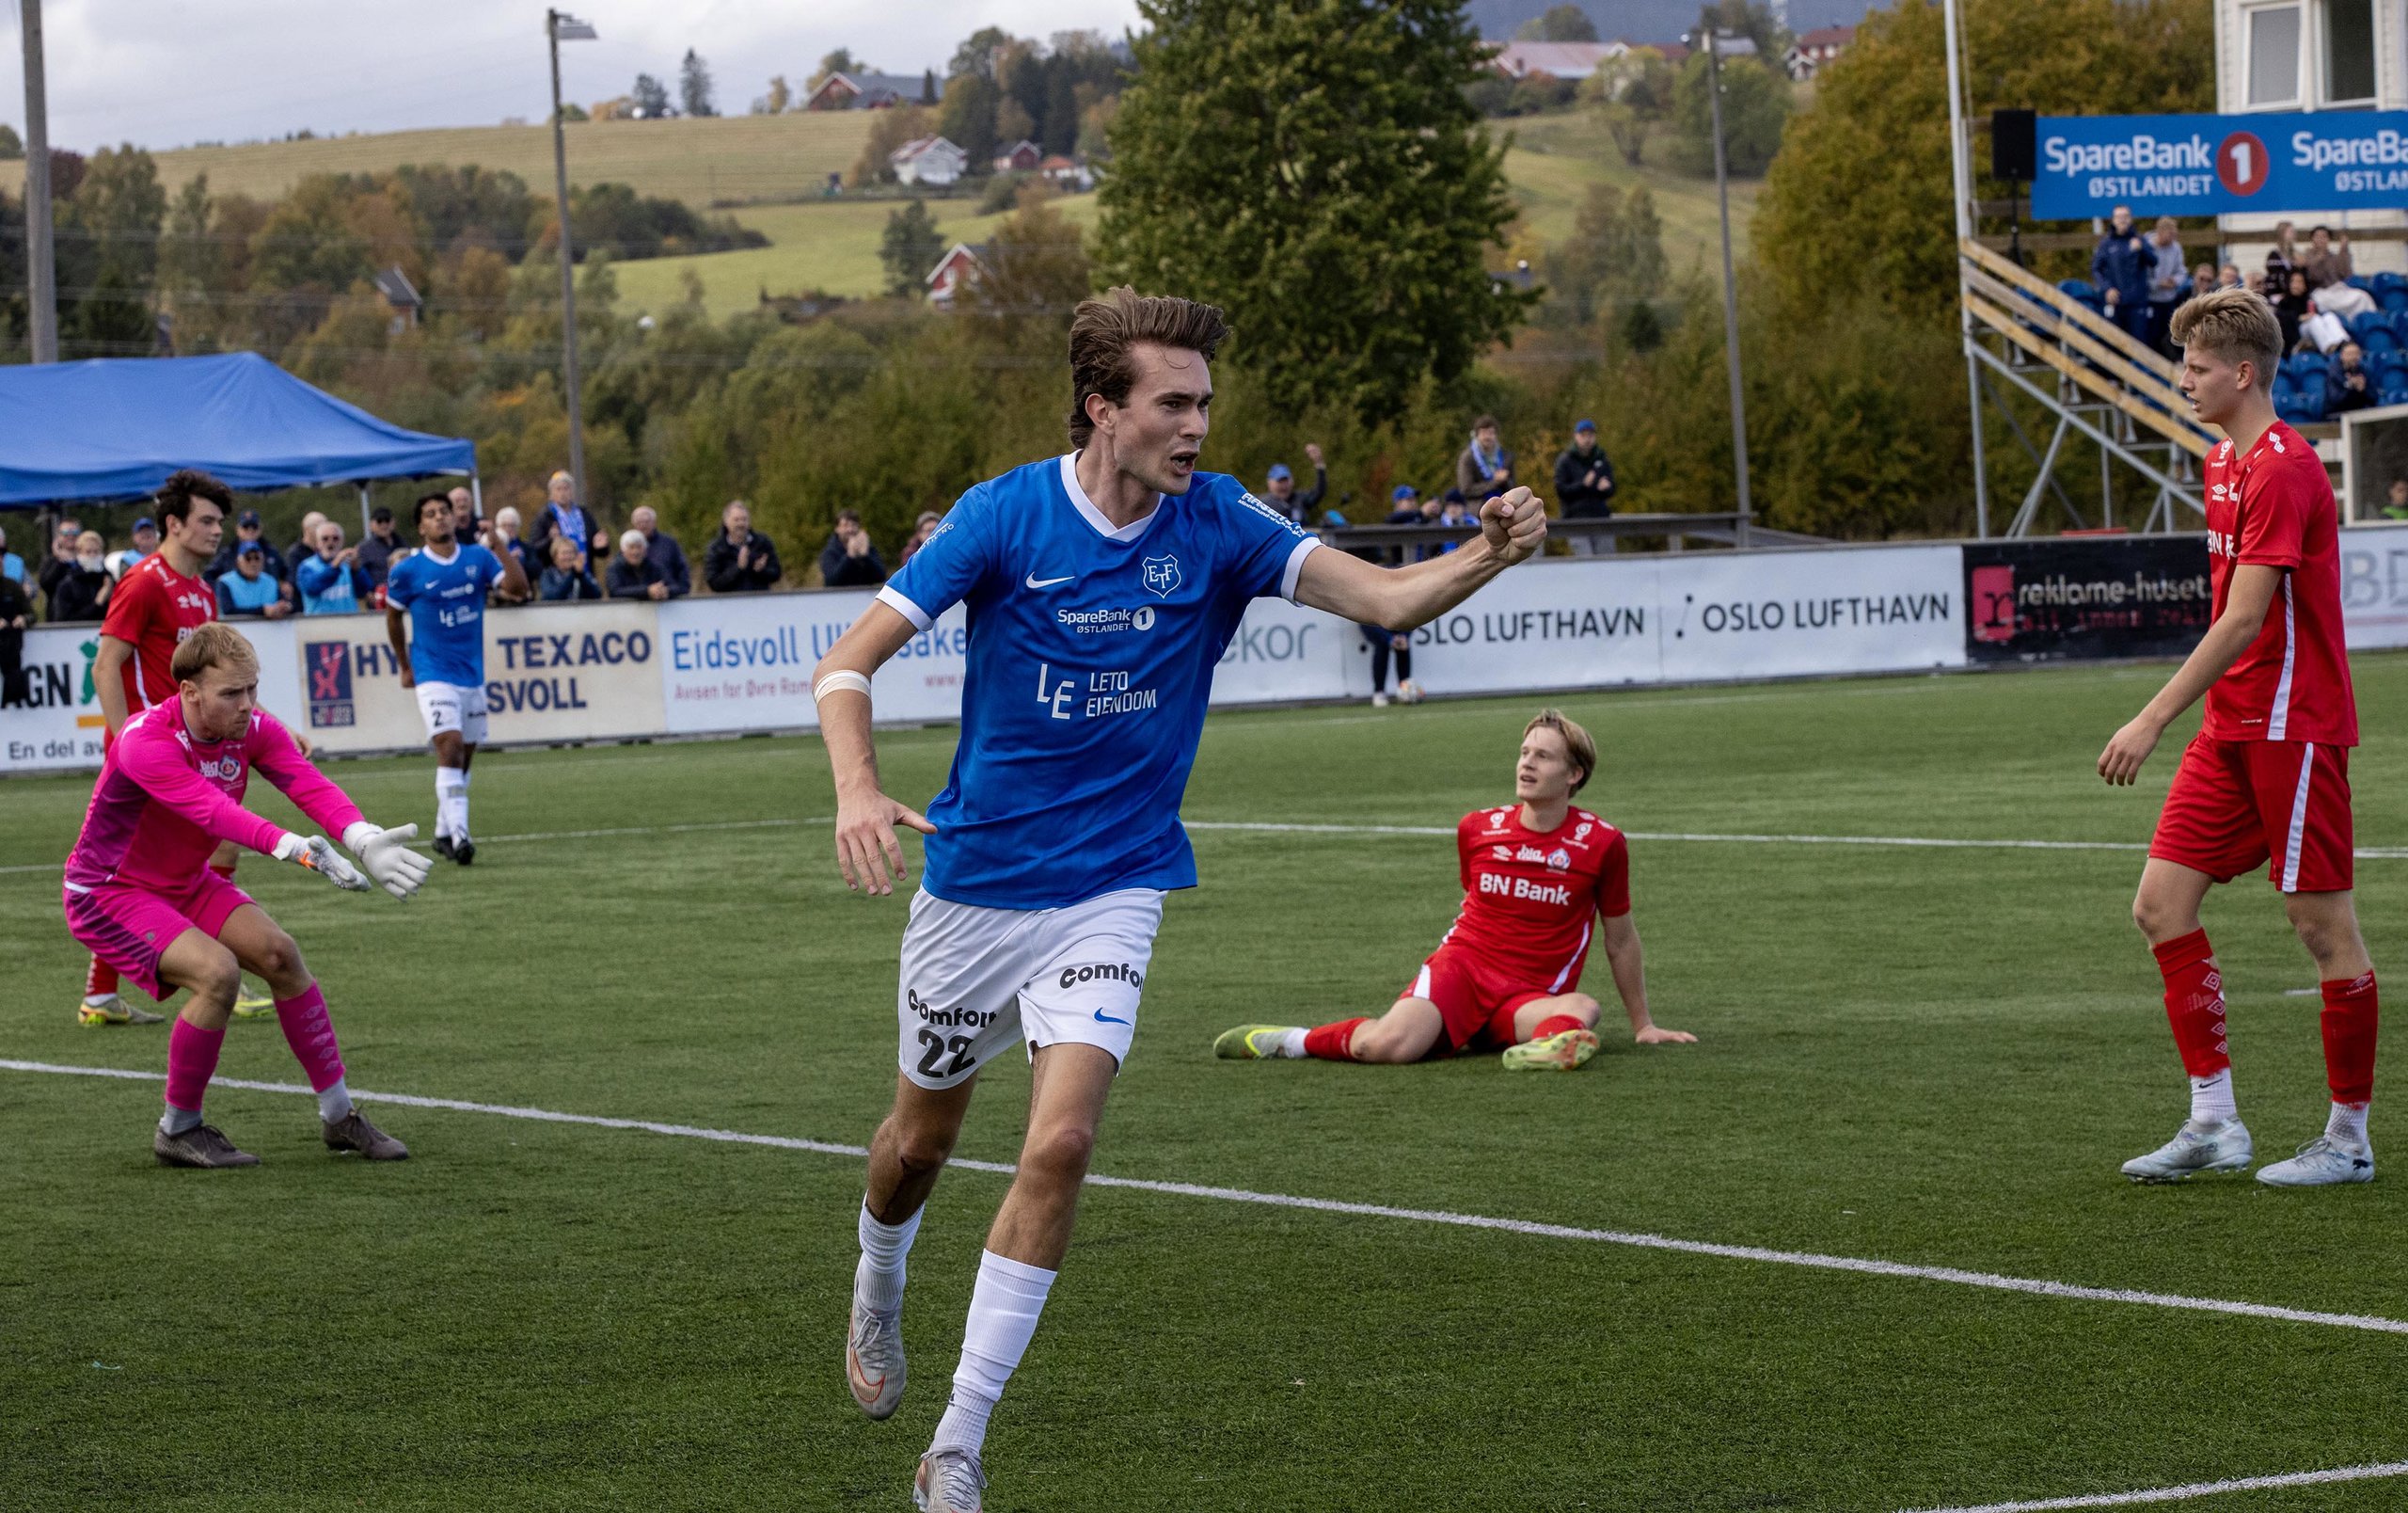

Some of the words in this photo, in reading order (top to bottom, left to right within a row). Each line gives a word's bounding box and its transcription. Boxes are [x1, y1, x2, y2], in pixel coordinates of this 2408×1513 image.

[2044, 134, 2211, 178] SpareBank
[2229, 142, 2252, 185] 1
[2088, 175, 2212, 198] ØSTLANDET
[2019, 571, 2211, 606] reklame-huset.
[1057, 608, 1132, 626] SpareBank
[1076, 623, 1131, 634] ØSTLANDET
[1415, 614, 1474, 645] SLO
[1484, 607, 1644, 642] LUFTHAVN
[1703, 602, 1784, 631] OSLO
[1794, 594, 1949, 628] LUFTHAVN
[497, 629, 652, 670] TEXACO
[673, 629, 800, 670] Eidsvoll
[485, 677, 587, 713] SVOLL
[1089, 671, 1129, 693] LETO
[433, 711, 443, 727] 2
[1085, 689, 1157, 717] EIENDOM
[8, 741, 36, 760] En
[44, 738, 74, 758] del
[1480, 873, 1511, 895] BN
[1513, 878, 1572, 906] Bank
[917, 1028, 975, 1078] 22
